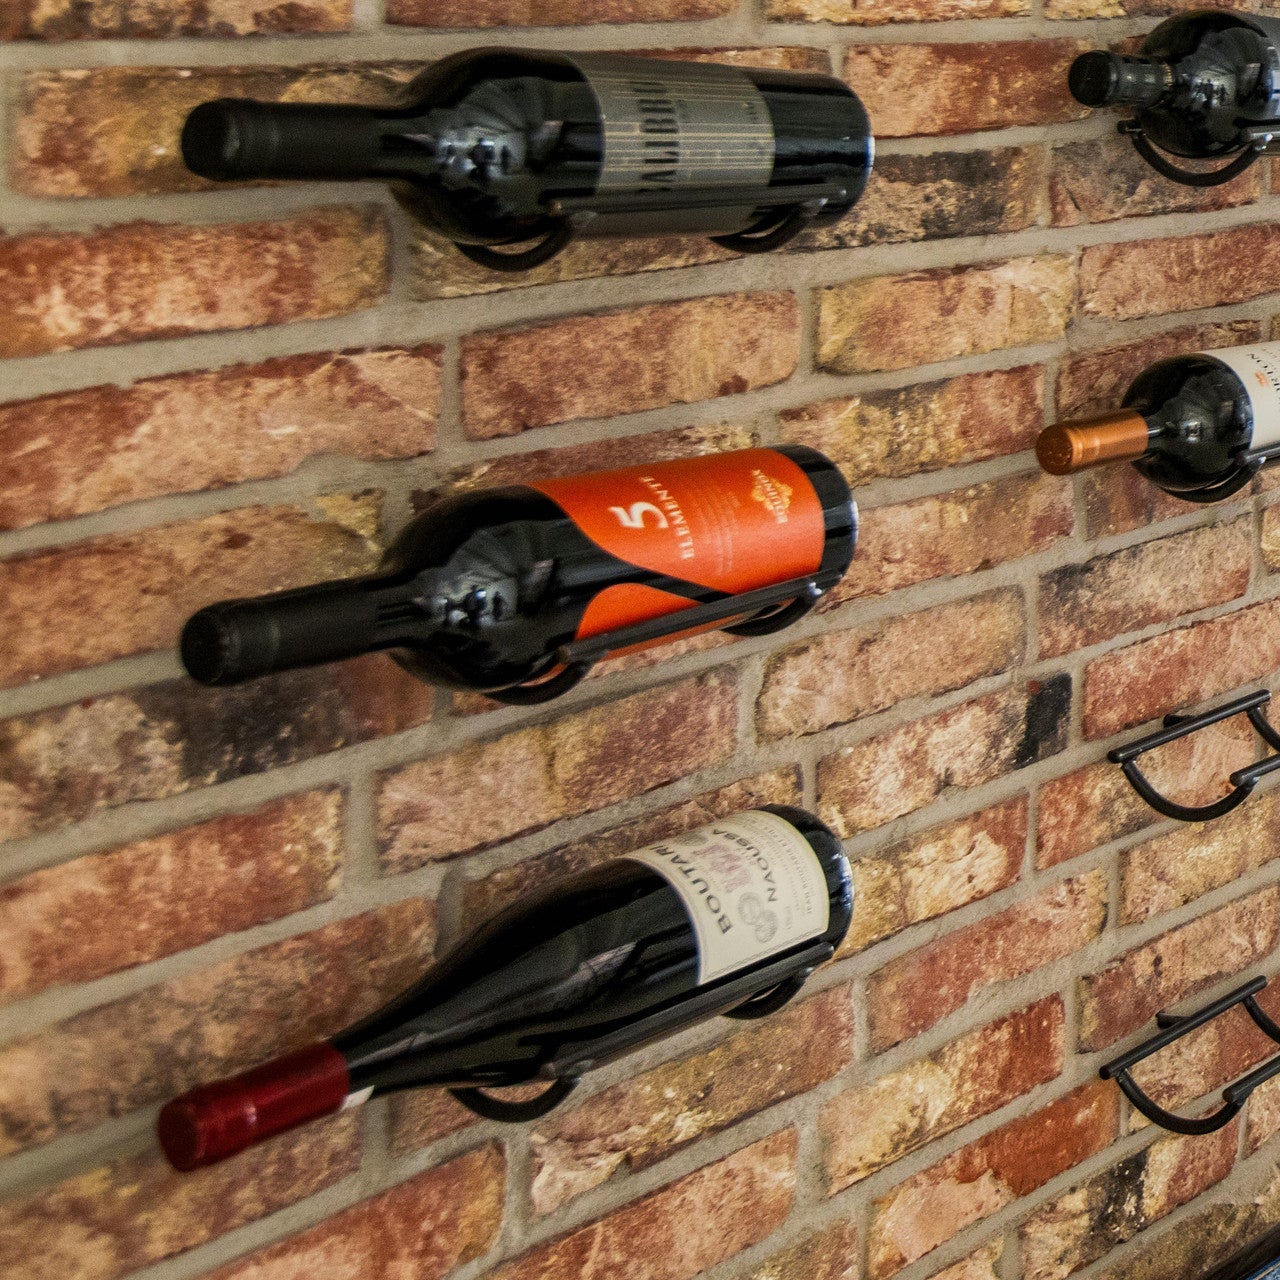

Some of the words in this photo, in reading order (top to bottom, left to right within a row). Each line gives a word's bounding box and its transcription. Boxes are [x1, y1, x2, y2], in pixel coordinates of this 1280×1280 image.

[608, 501, 669, 527] 5
[641, 474, 695, 561] ELEMENTE
[751, 469, 788, 524] EQUINOX
[650, 842, 734, 935] BOUTARI
[712, 825, 780, 904] NAOUSSA
